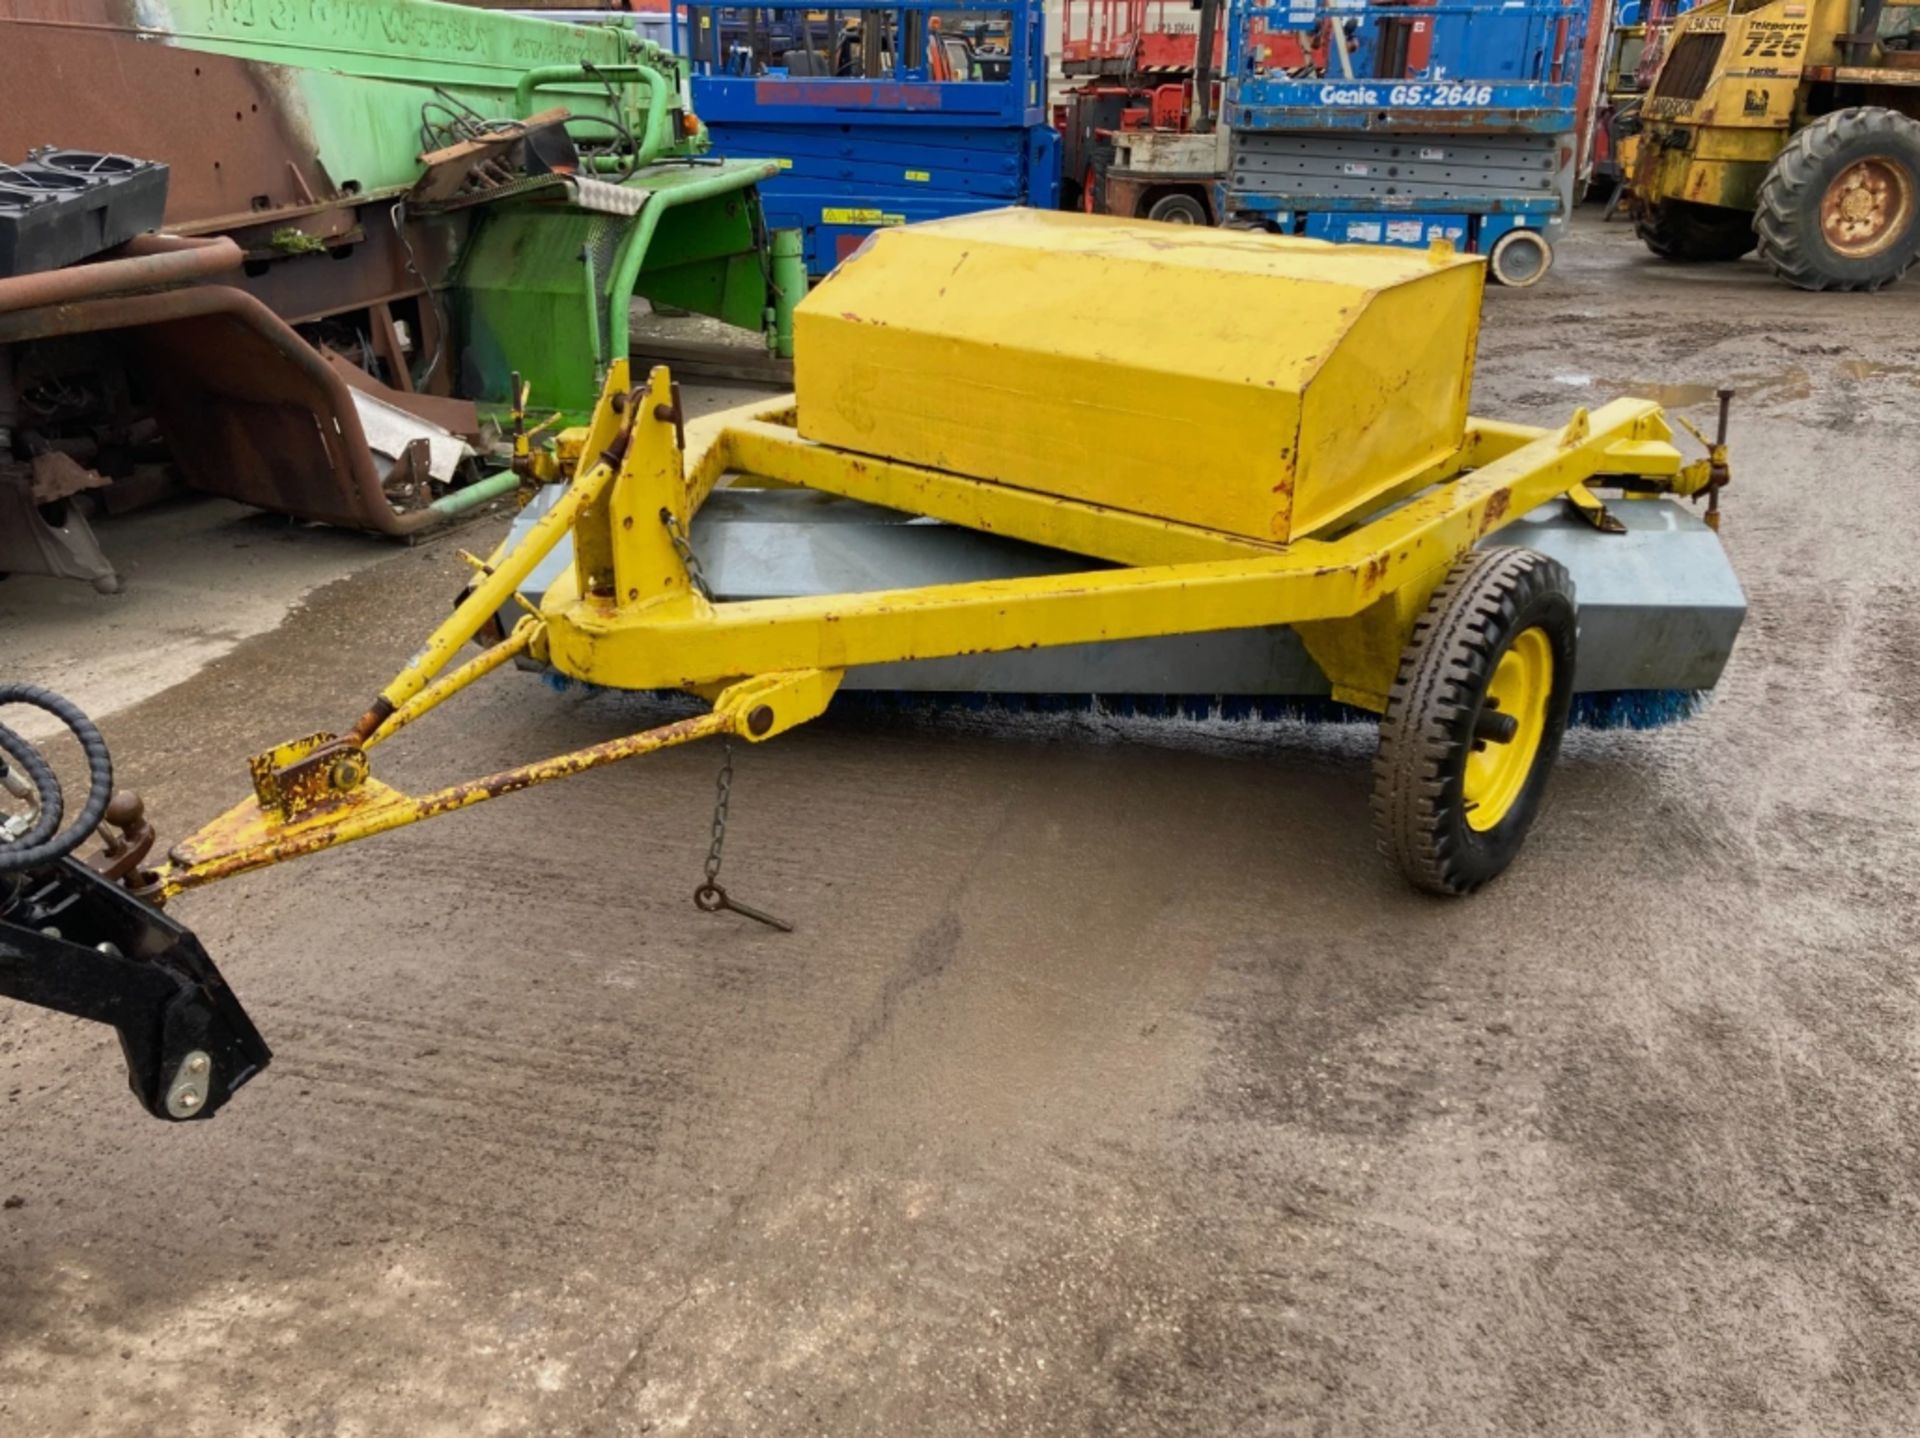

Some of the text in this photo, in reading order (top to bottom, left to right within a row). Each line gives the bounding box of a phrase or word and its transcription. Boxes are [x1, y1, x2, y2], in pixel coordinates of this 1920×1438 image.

[1749, 21, 1808, 30] Teleporter
[1742, 32, 1806, 58] 726
[1319, 85, 1493, 106] Genie GS-2646
